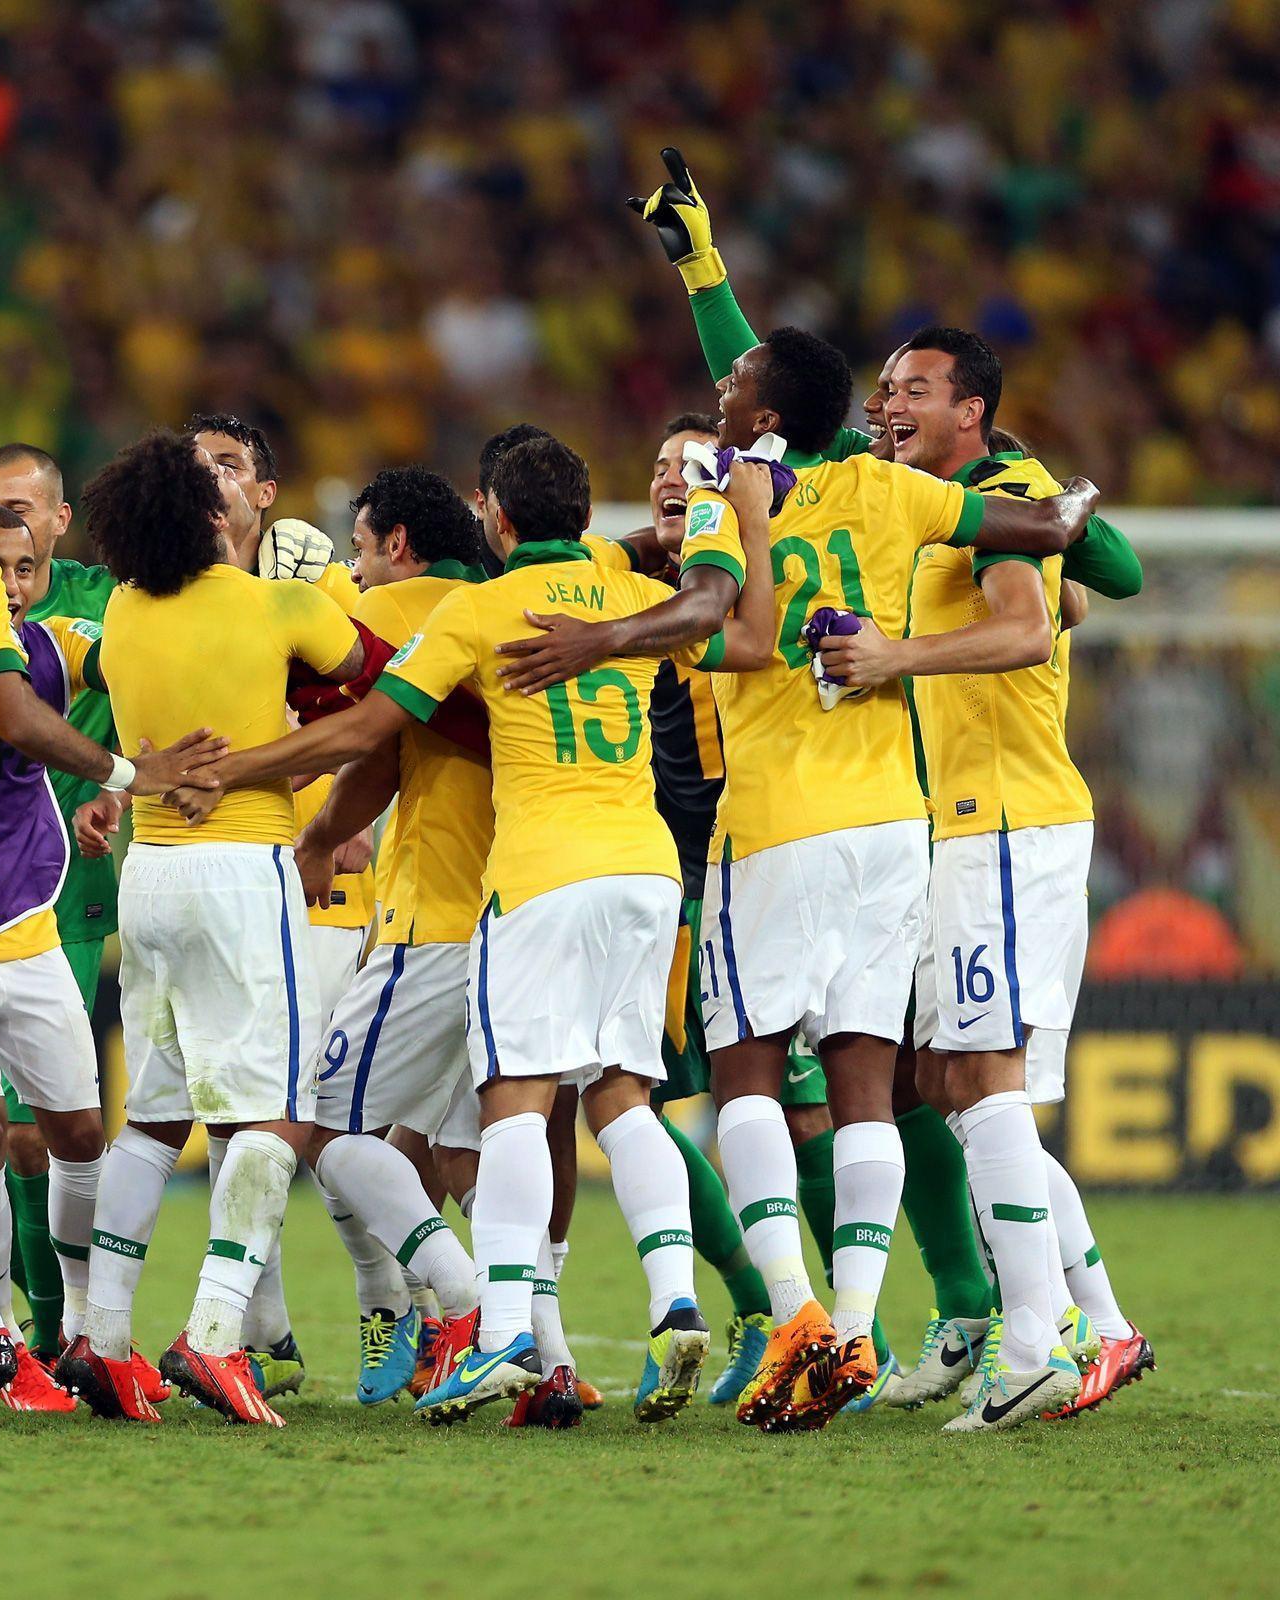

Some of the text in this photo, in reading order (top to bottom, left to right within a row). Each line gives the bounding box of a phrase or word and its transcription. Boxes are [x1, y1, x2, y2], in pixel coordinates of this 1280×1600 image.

[795, 478, 821, 507] JÓ
[545, 581, 605, 611] JEAN
[770, 529, 873, 670] 21
[545, 667, 642, 764] 15
[951, 944, 995, 1005] 16
[318, 1029, 349, 1081] 9
[766, 1201, 798, 1215] BRAS
[98, 1234, 139, 1257] BRASIL
